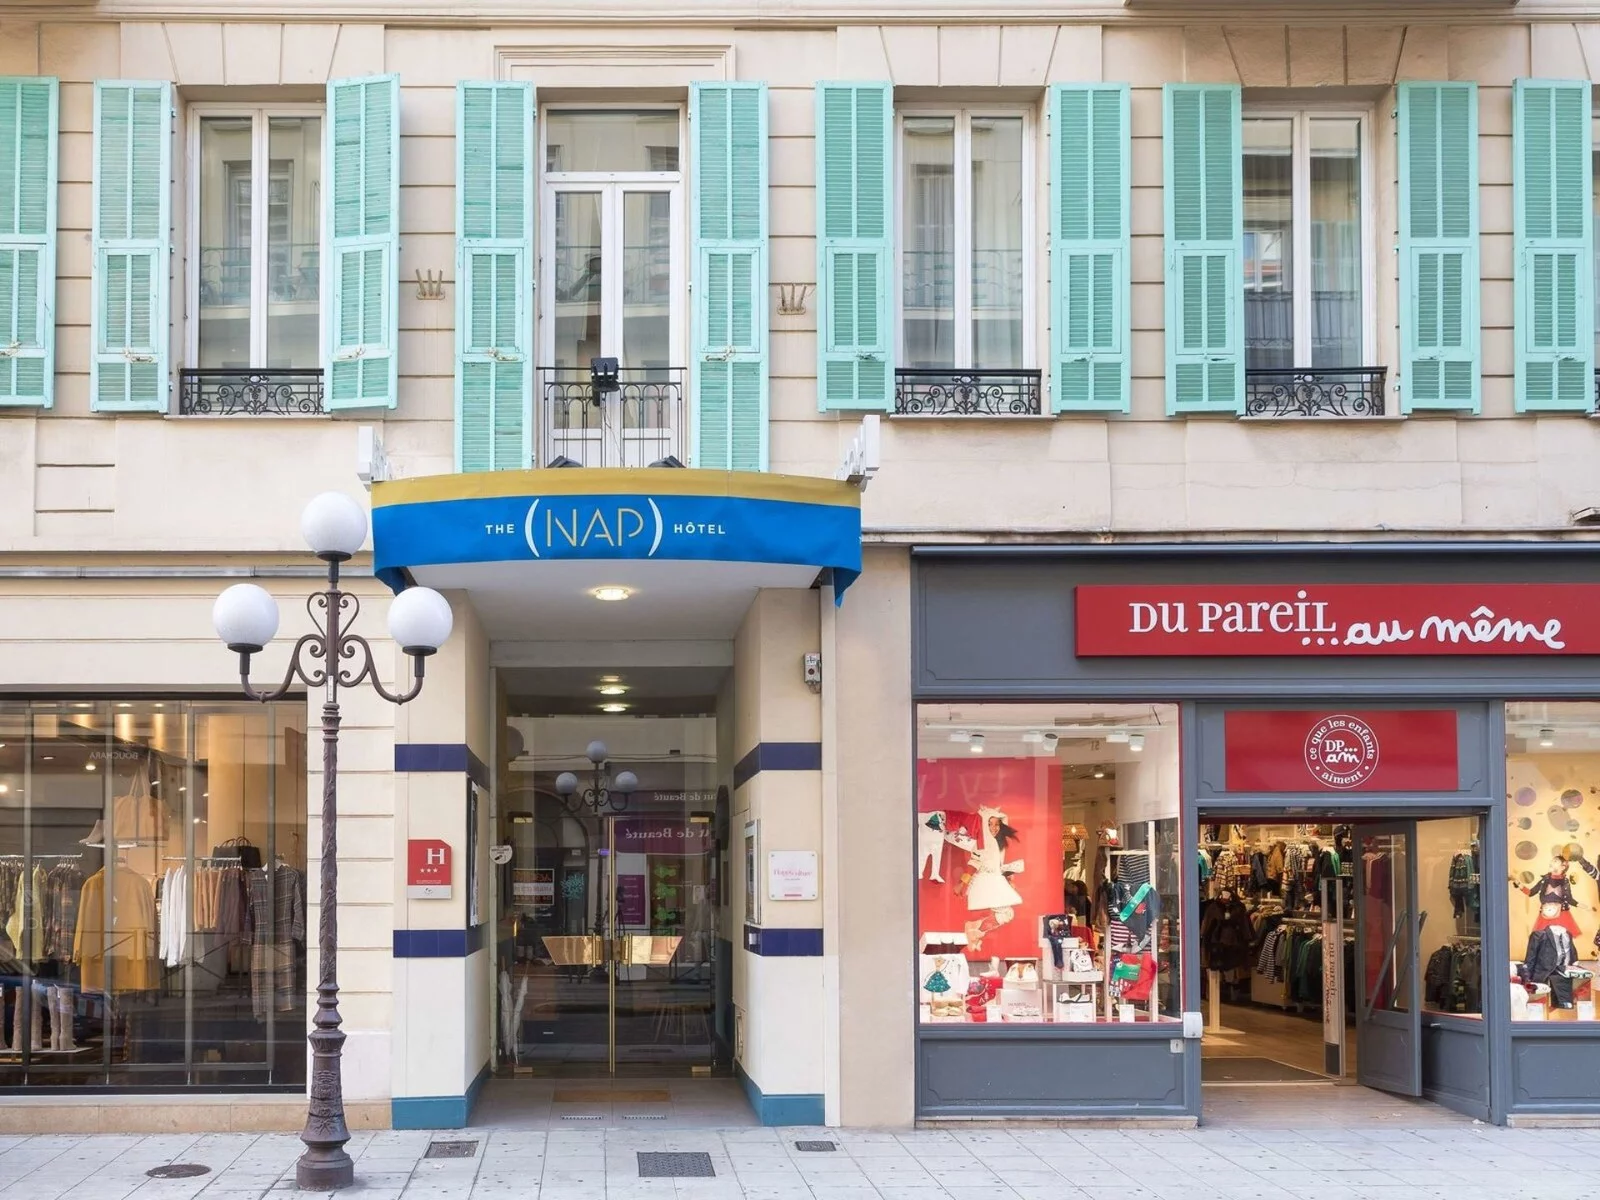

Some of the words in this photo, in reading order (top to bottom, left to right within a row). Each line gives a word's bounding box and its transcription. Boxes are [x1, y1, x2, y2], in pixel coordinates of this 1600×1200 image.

[485, 523, 515, 535] THE
[674, 521, 726, 535] HÔTEL
[1419, 605, 1566, 650] même
[1328, 719, 1346, 729] les
[1311, 726, 1328, 745] que
[1348, 721, 1376, 760] enfants
[1309, 747, 1318, 760] ce
[1325, 752, 1360, 764] am
[1321, 771, 1364, 784] aiment
[427, 847, 445, 865] H
